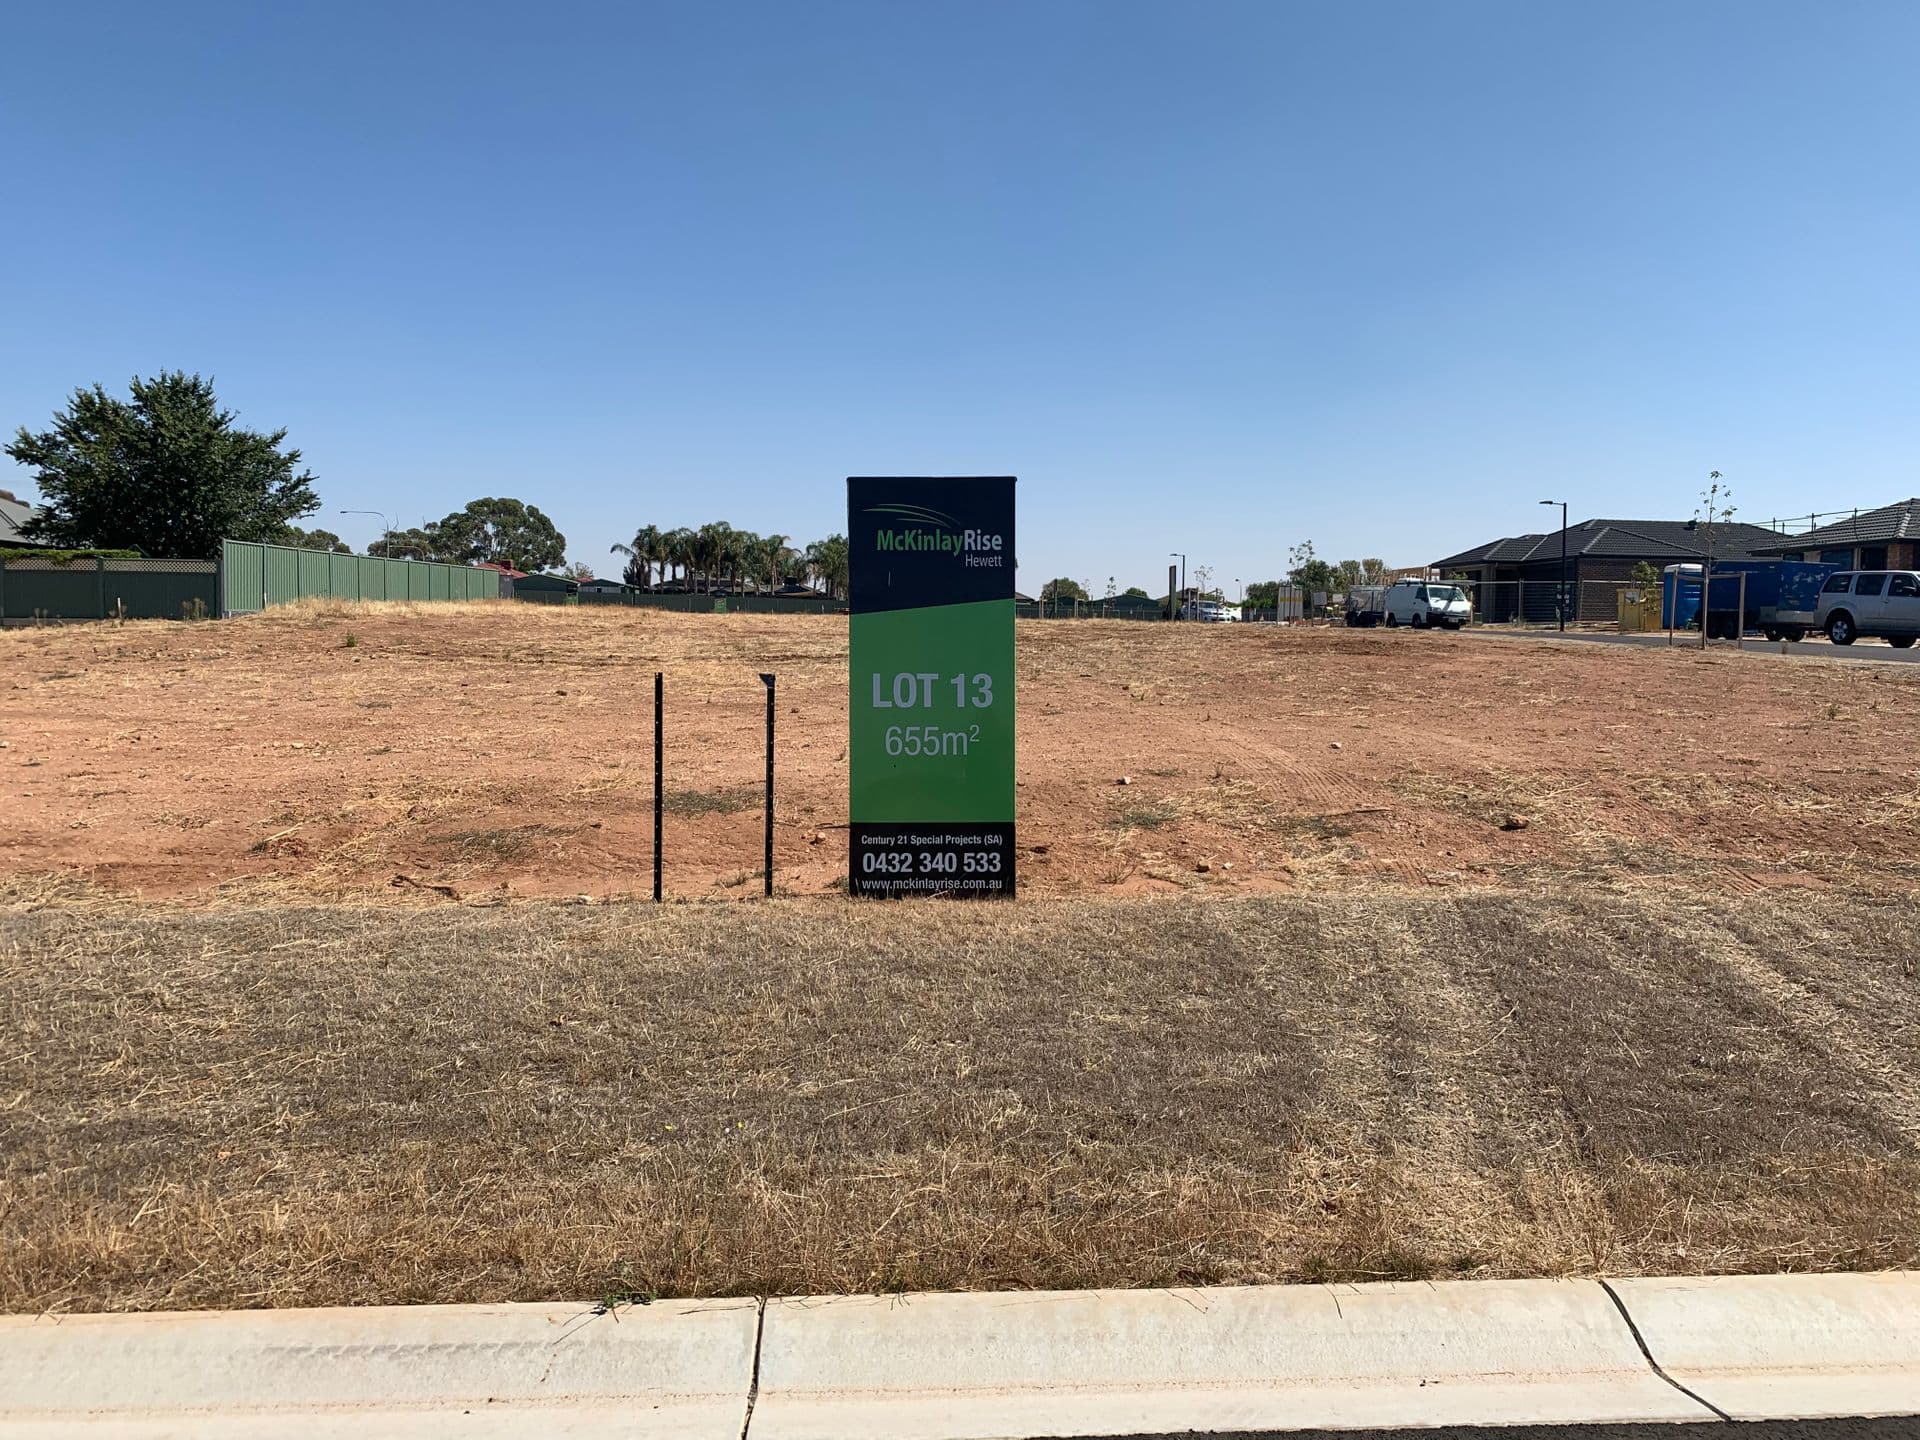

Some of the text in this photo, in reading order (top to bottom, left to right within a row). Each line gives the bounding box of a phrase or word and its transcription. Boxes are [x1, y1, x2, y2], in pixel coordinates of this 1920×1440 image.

[965, 554, 1002, 568] Hewett
[872, 673, 993, 708] LOT 13
[861, 834, 1003, 846] Century 21 Special Projects (SA)
[862, 852, 1001, 873] 0432 340 533
[862, 878, 1002, 891] www.mckinlayrise.com.au
